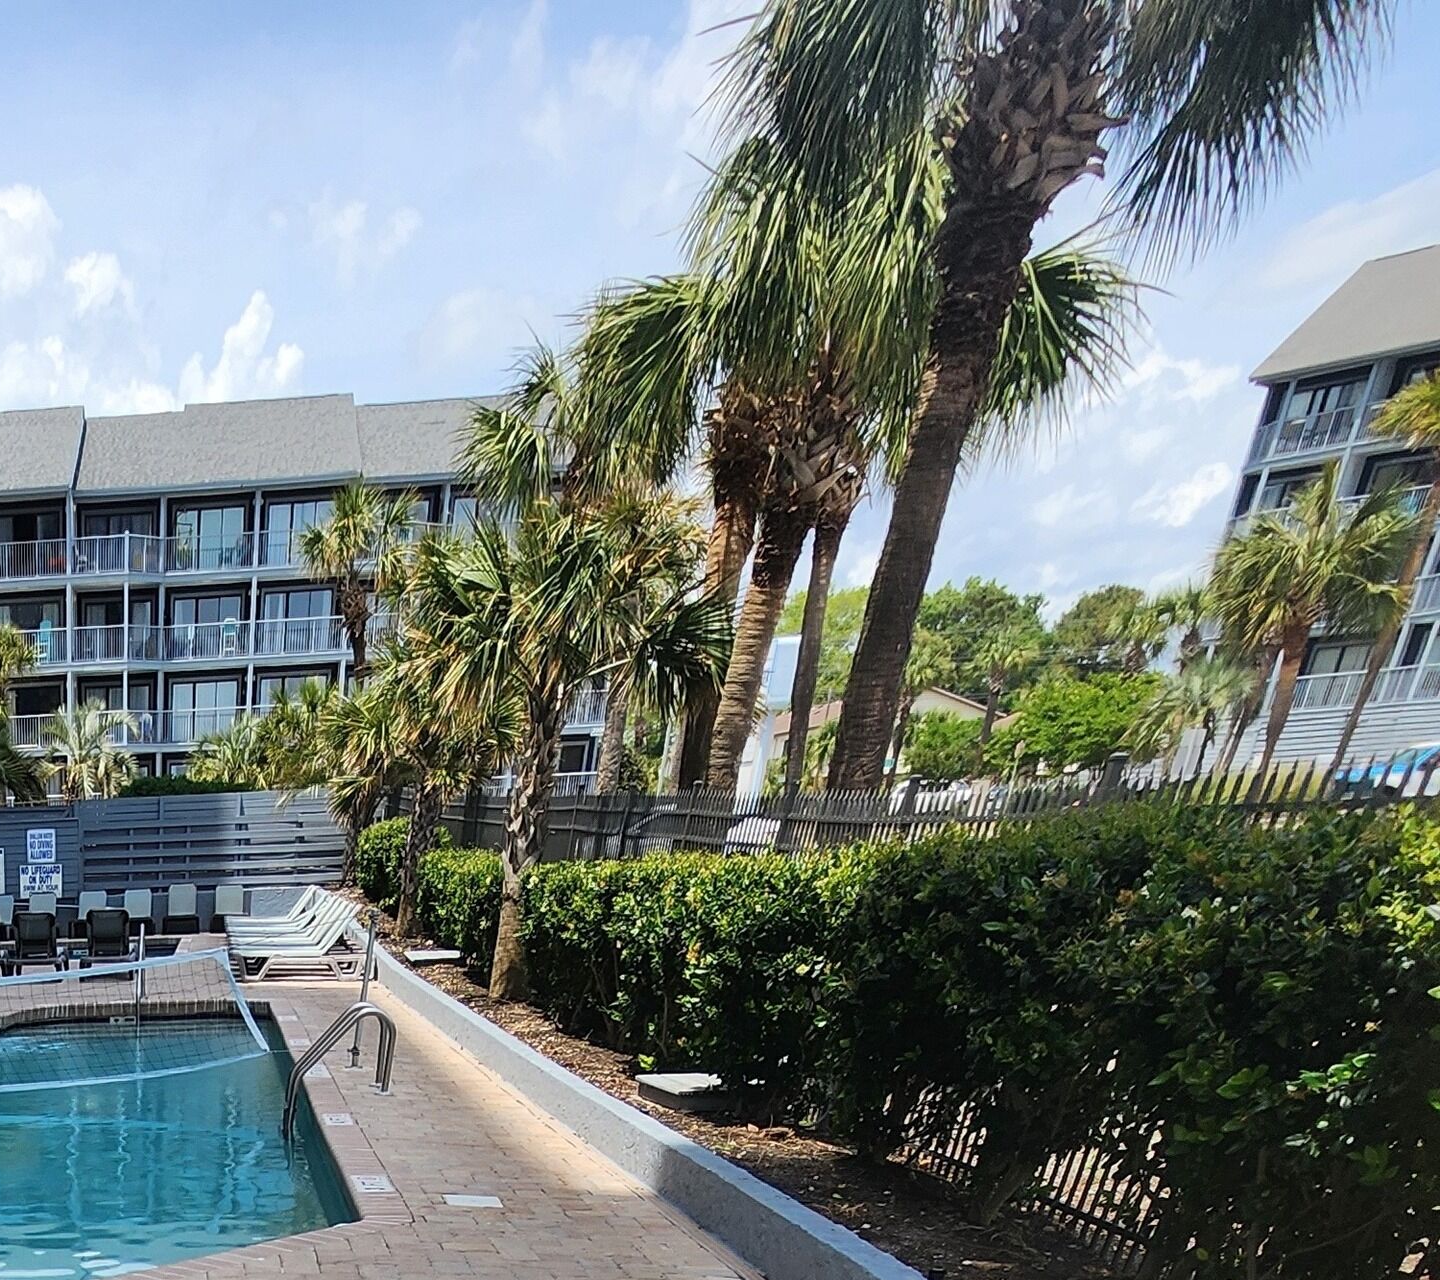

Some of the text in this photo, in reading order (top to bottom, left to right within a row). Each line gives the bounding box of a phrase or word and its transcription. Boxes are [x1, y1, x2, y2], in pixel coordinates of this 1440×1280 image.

[29, 840, 53, 849] NO DIVING
[30, 850, 53, 860] ALLOWED
[20, 866, 60, 875] NO LIFEGUARD
[29, 876, 53, 884] ON DUTY
